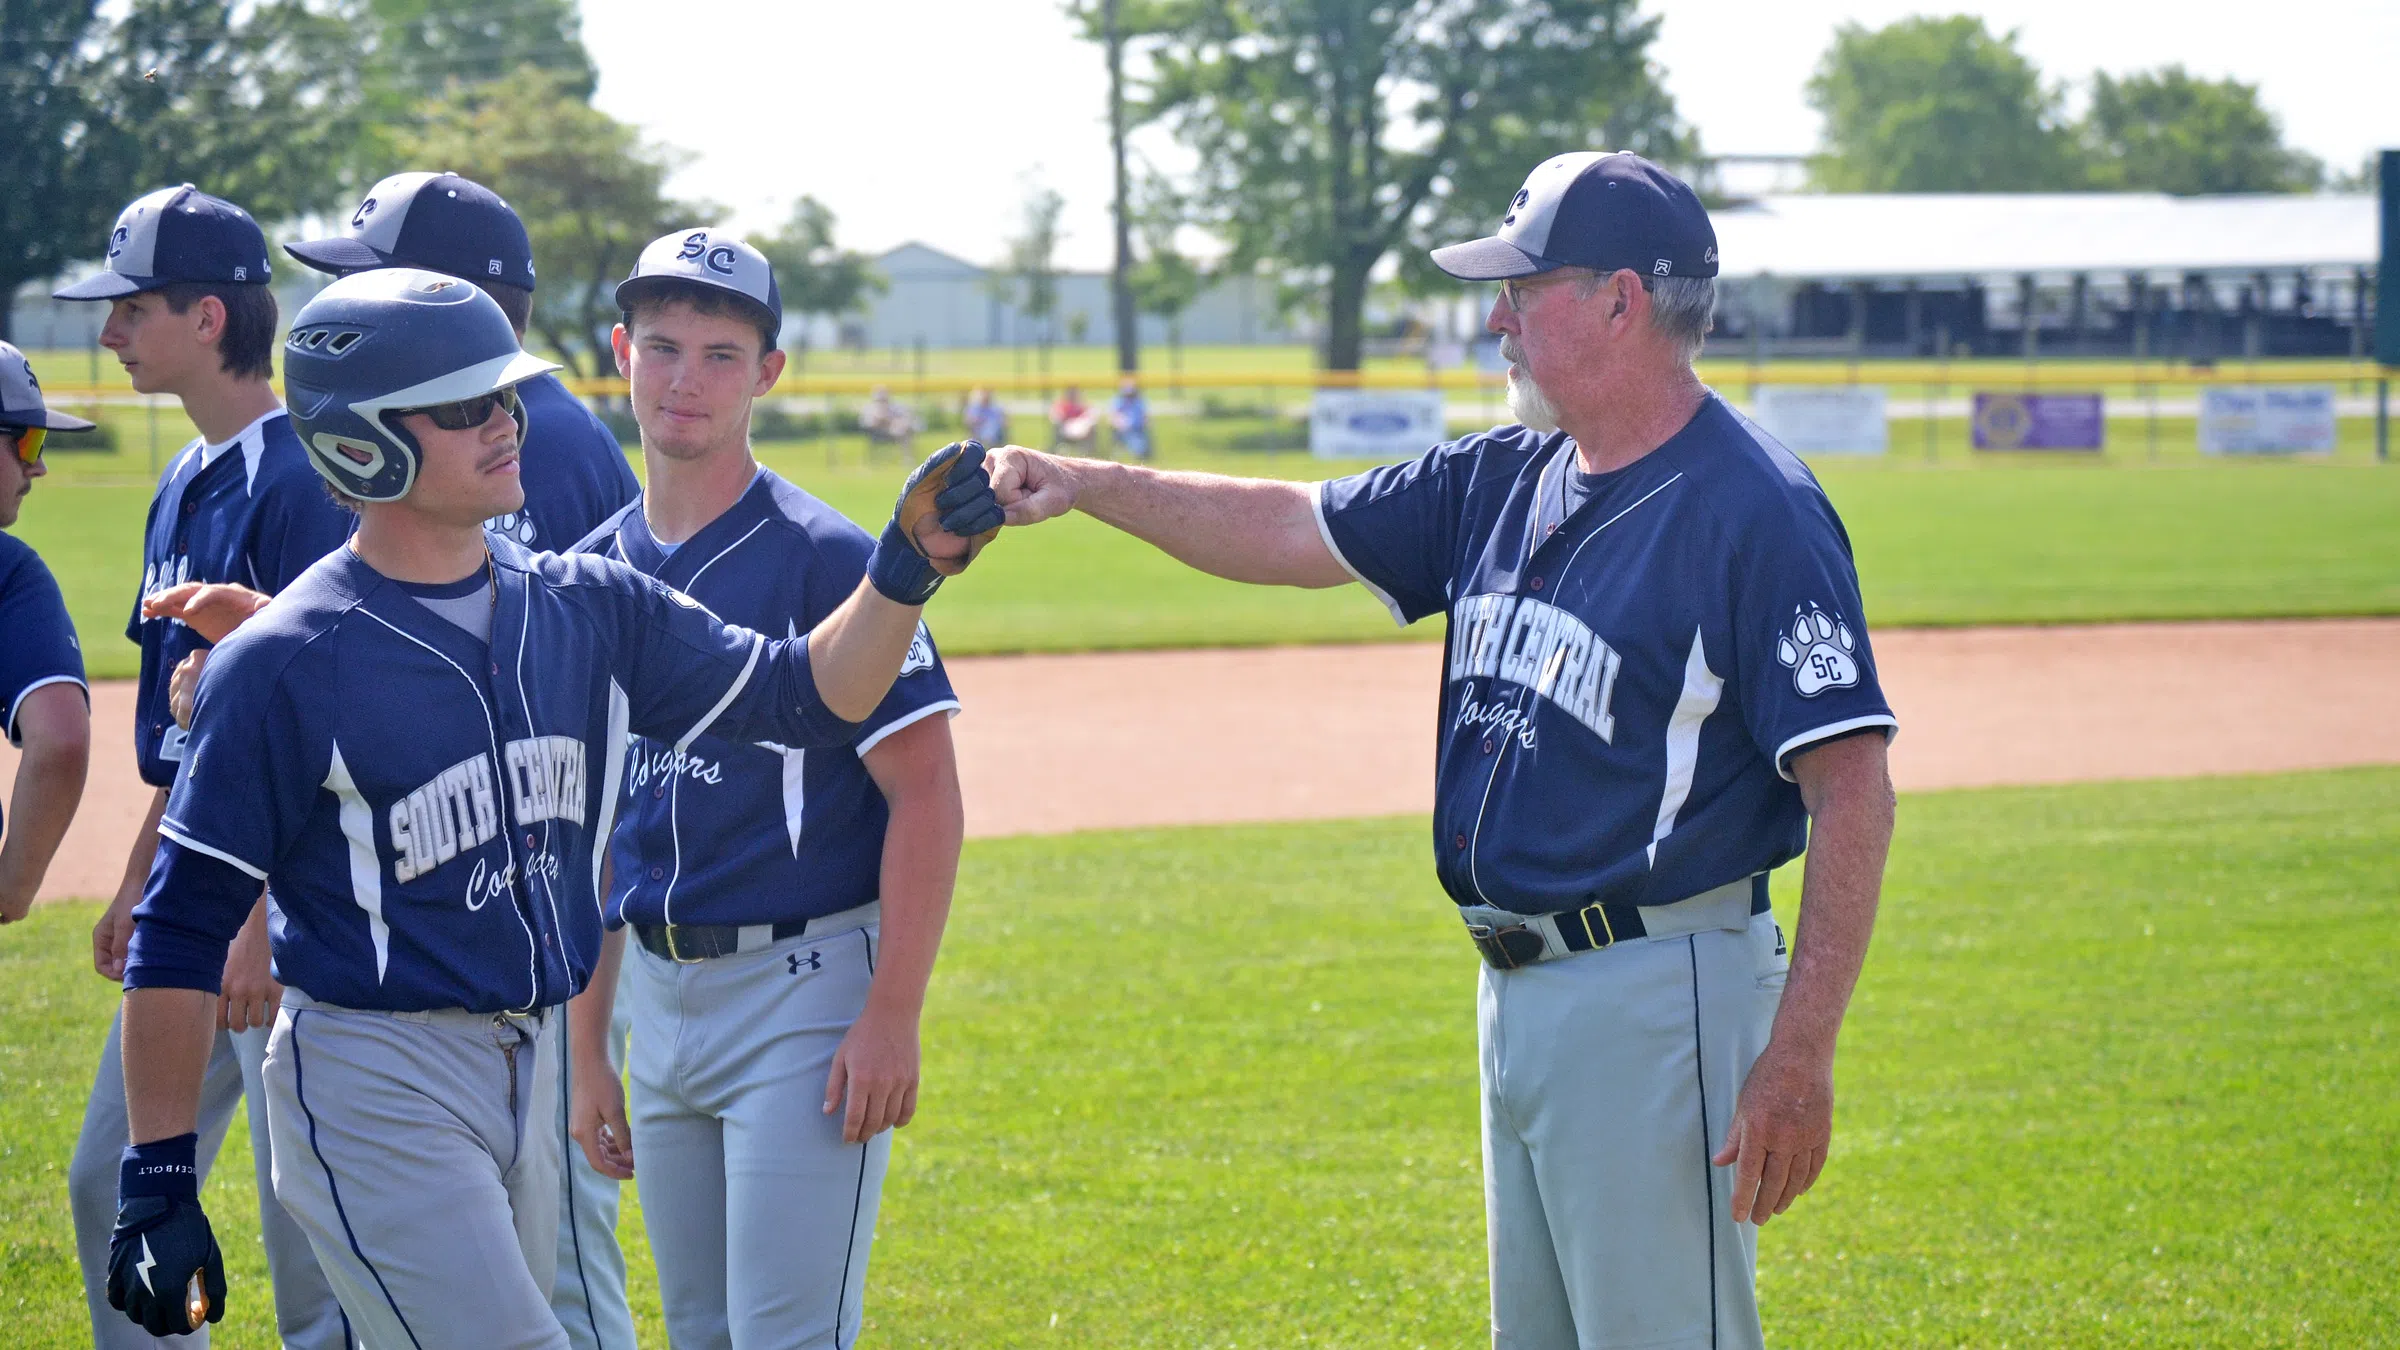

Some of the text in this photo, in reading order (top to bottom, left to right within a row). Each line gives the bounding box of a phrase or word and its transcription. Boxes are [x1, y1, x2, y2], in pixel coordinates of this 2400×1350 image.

[109, 226, 128, 259] C
[676, 231, 737, 276] SC
[1499, 597, 1623, 746] CENTRAL
[1811, 653, 1842, 681] SC
[1454, 681, 1537, 749] Cougars
[389, 752, 498, 885] SOUTH
